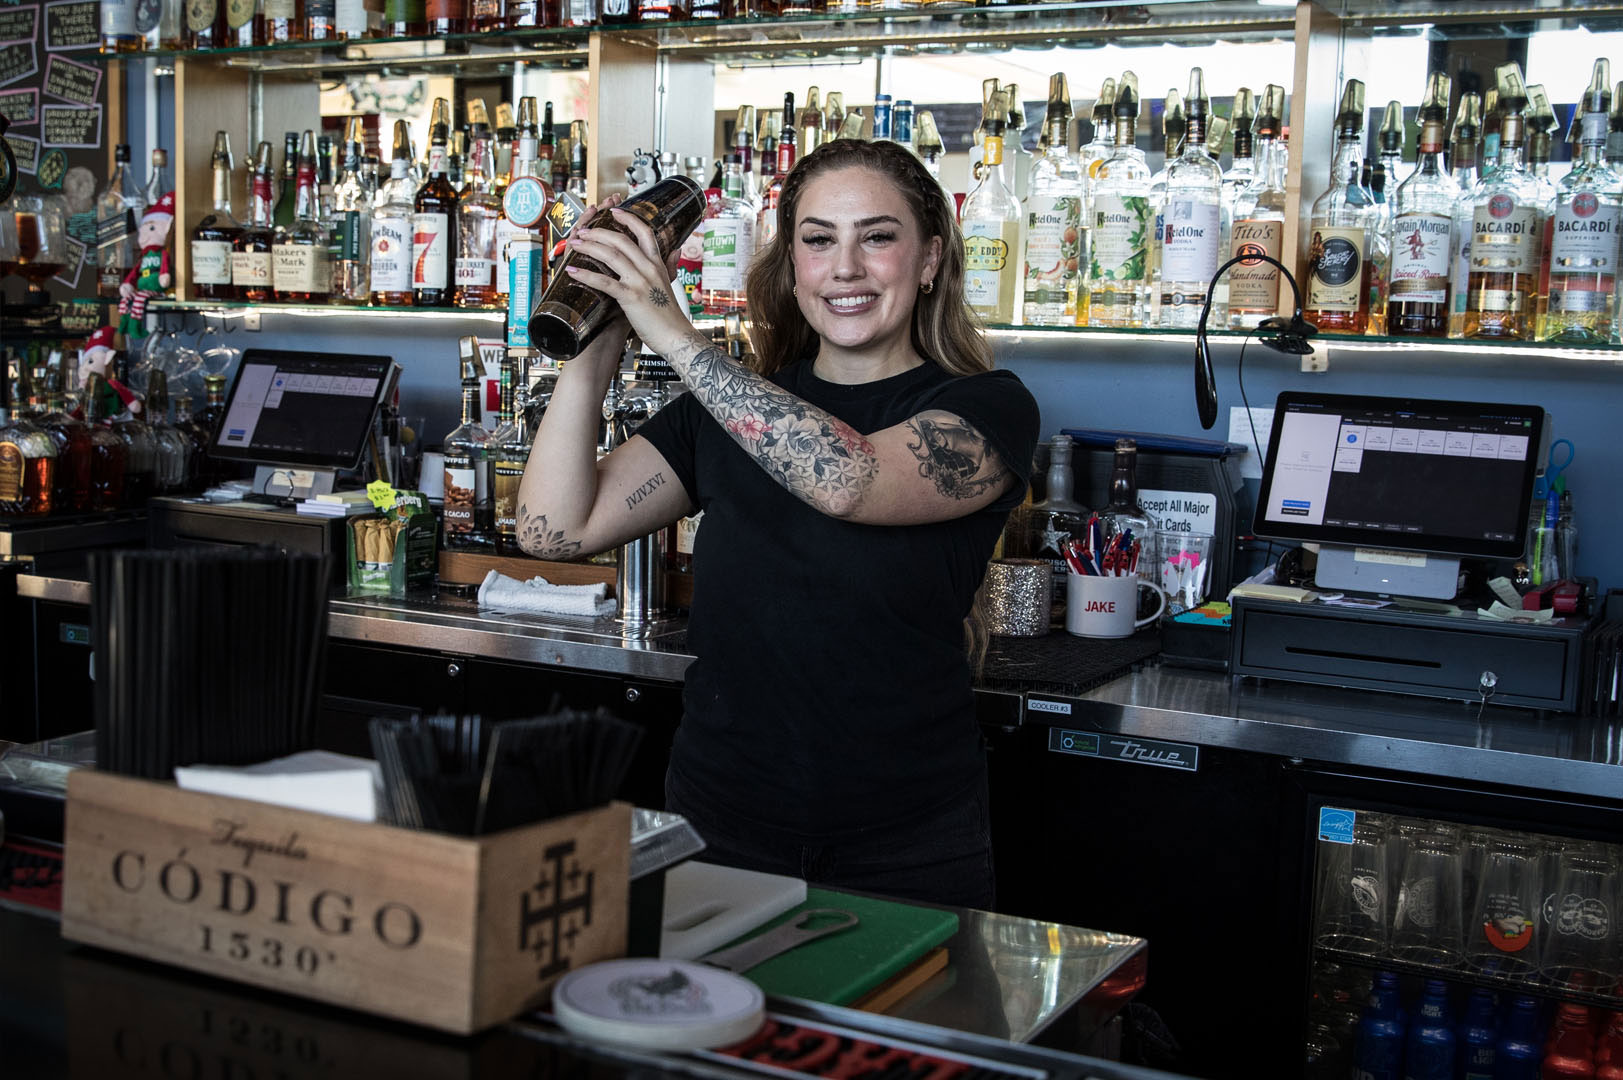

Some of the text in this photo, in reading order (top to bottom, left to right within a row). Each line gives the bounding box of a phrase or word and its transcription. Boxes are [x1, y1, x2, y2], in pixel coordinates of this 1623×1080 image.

[1029, 212, 1061, 229] Ketel One
[1097, 212, 1130, 228] Ketel One
[1475, 220, 1526, 234] BACARDÍ
[1558, 219, 1611, 233] BACARDÍ
[1165, 224, 1186, 244] Ketel
[1186, 226, 1204, 238] One
[414, 232, 438, 284] 7
[448, 511, 471, 519] CACAO
[1170, 500, 1182, 513] All
[1184, 501, 1210, 516] Major
[1165, 518, 1192, 533] Cards
[1084, 601, 1116, 613] JAKE
[1031, 702, 1069, 713] COOLER #3
[112, 848, 423, 951] CÓDIGO
